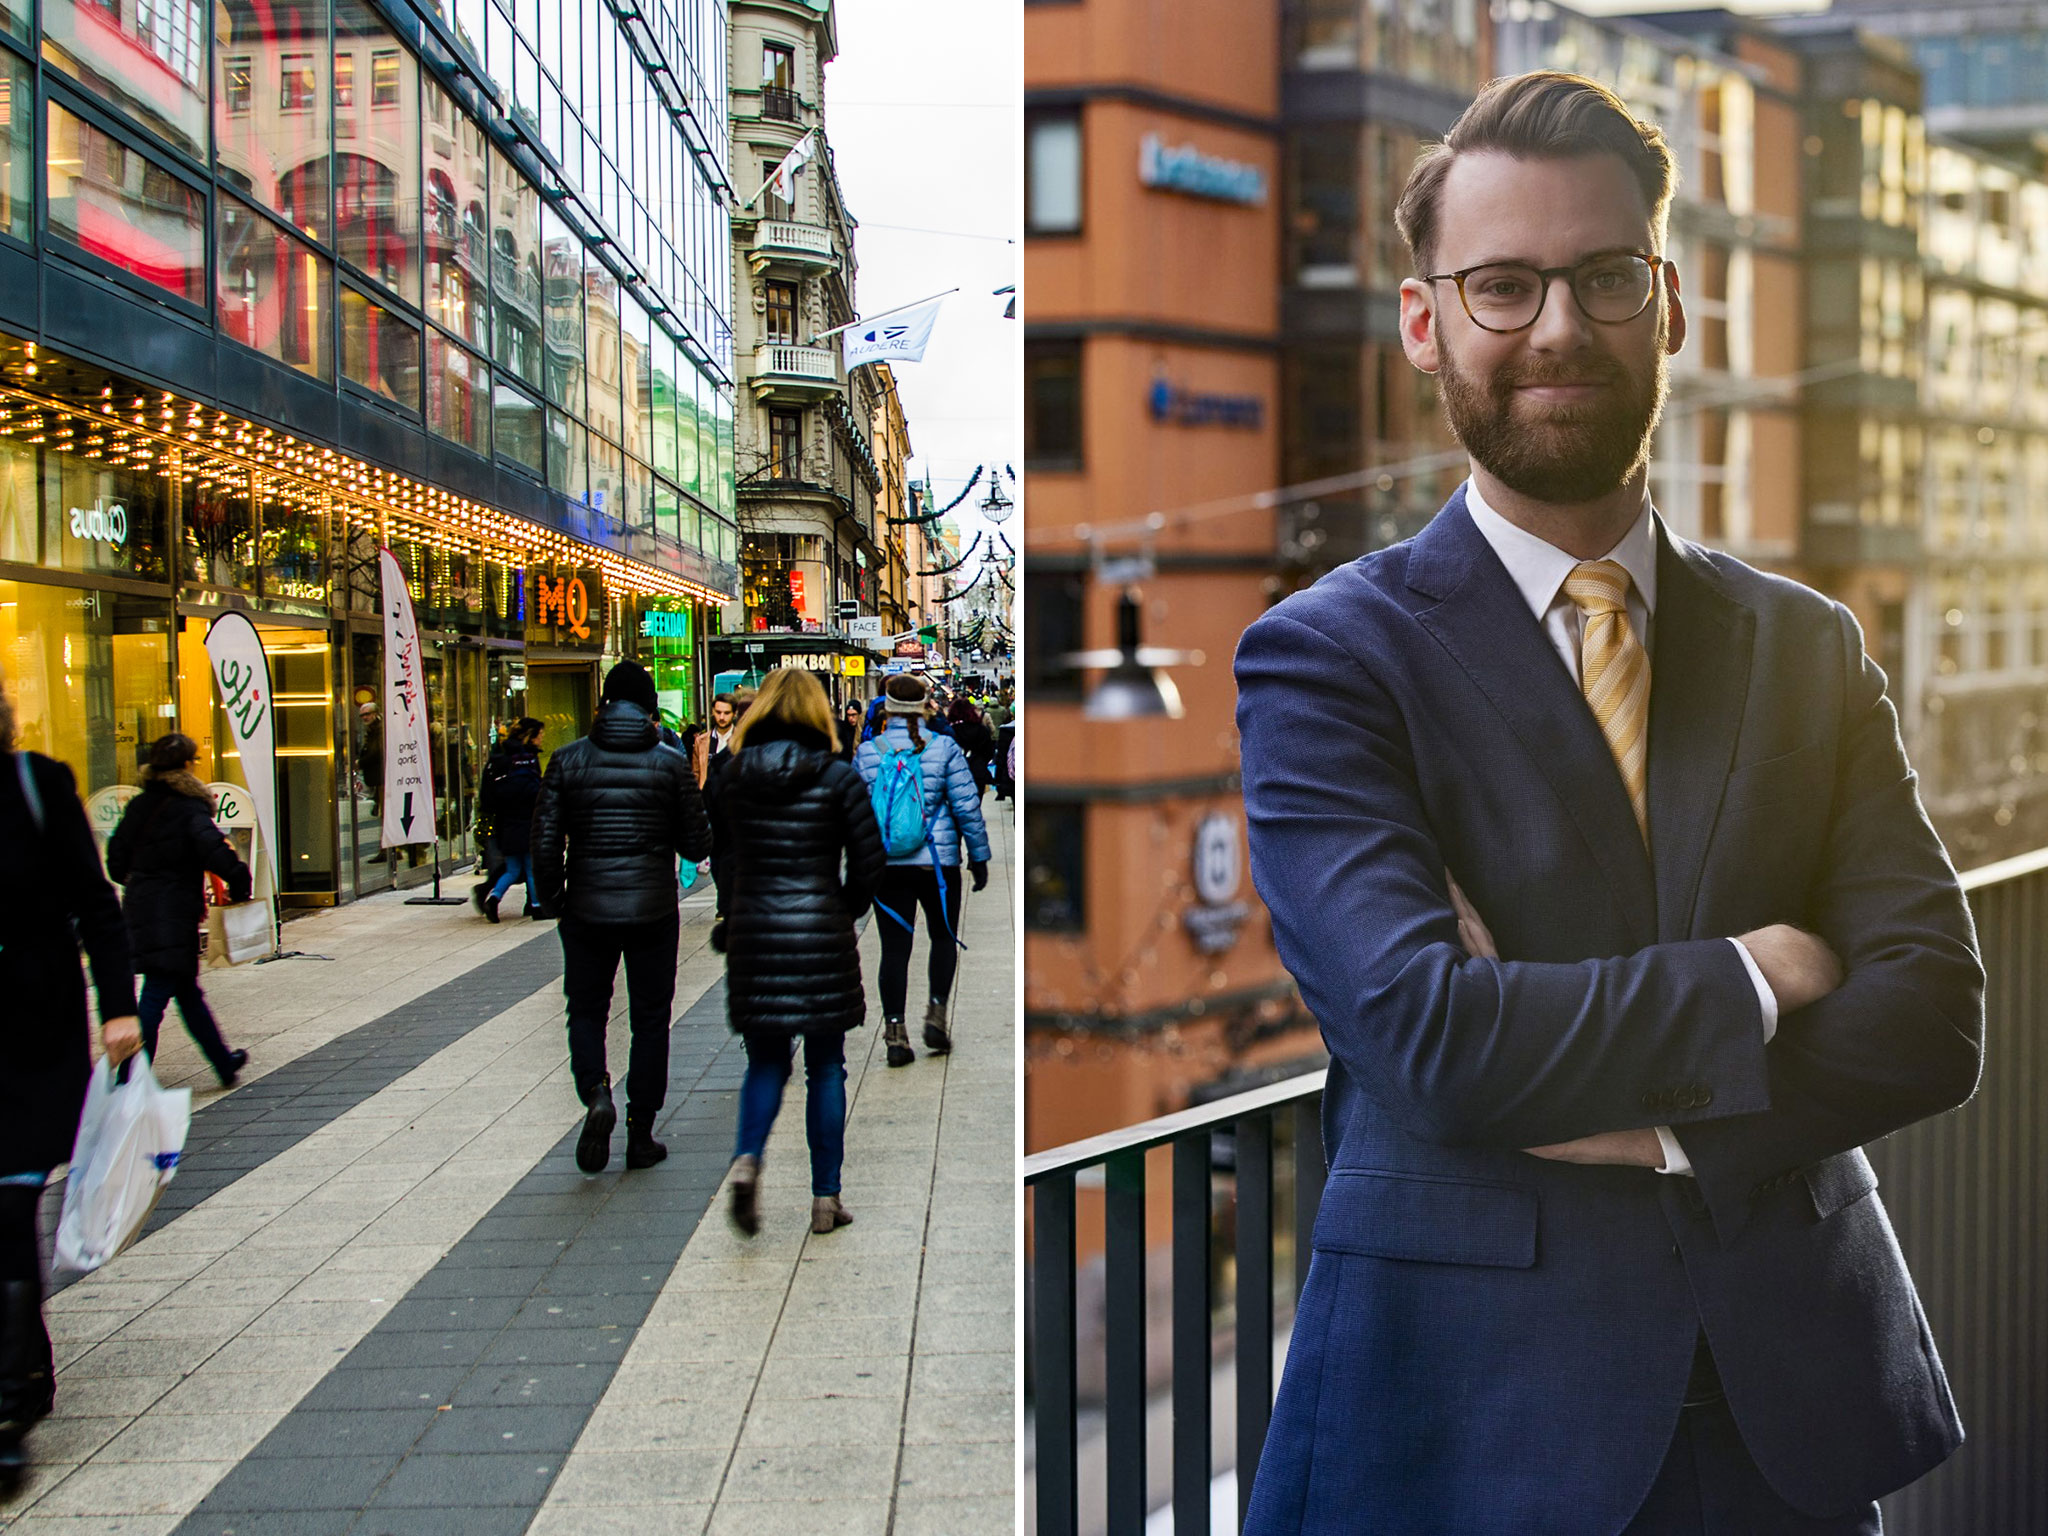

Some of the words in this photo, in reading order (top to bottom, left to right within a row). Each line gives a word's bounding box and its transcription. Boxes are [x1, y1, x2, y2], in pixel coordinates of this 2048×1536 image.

[538, 575, 590, 639] MQ
[645, 610, 687, 638] WEEKDAY
[853, 621, 878, 632] FACE
[781, 654, 809, 670] BIK
